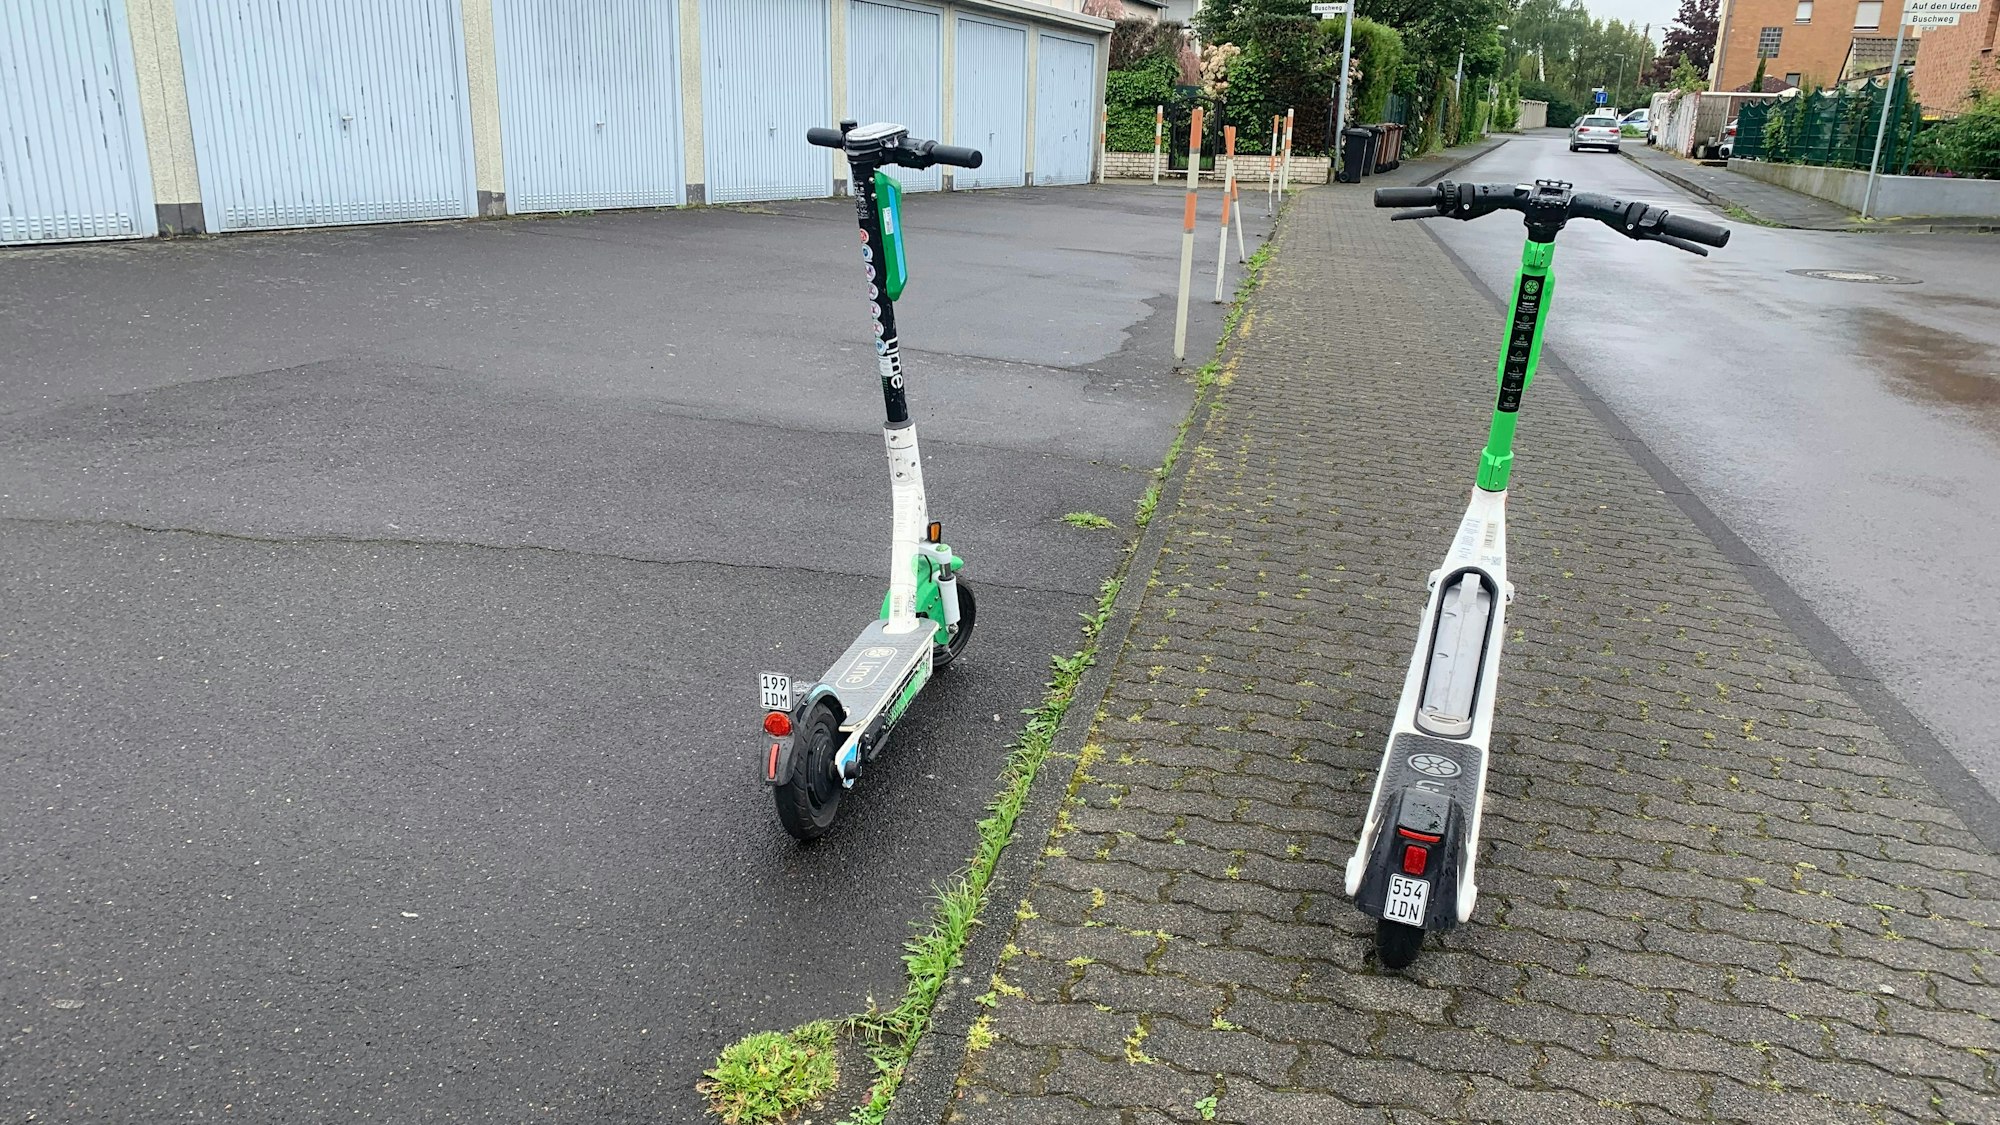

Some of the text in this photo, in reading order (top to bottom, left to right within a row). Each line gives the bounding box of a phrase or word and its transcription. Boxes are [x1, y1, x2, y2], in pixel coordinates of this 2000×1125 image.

[1912, 2, 1978, 10] Auf den Urden
[1912, 15, 1954, 23] Buschweg
[762, 676, 787, 691] 199
[764, 692, 788, 708] IDM
[1393, 878, 1423, 900] 554
[1389, 899, 1419, 921] IDN
